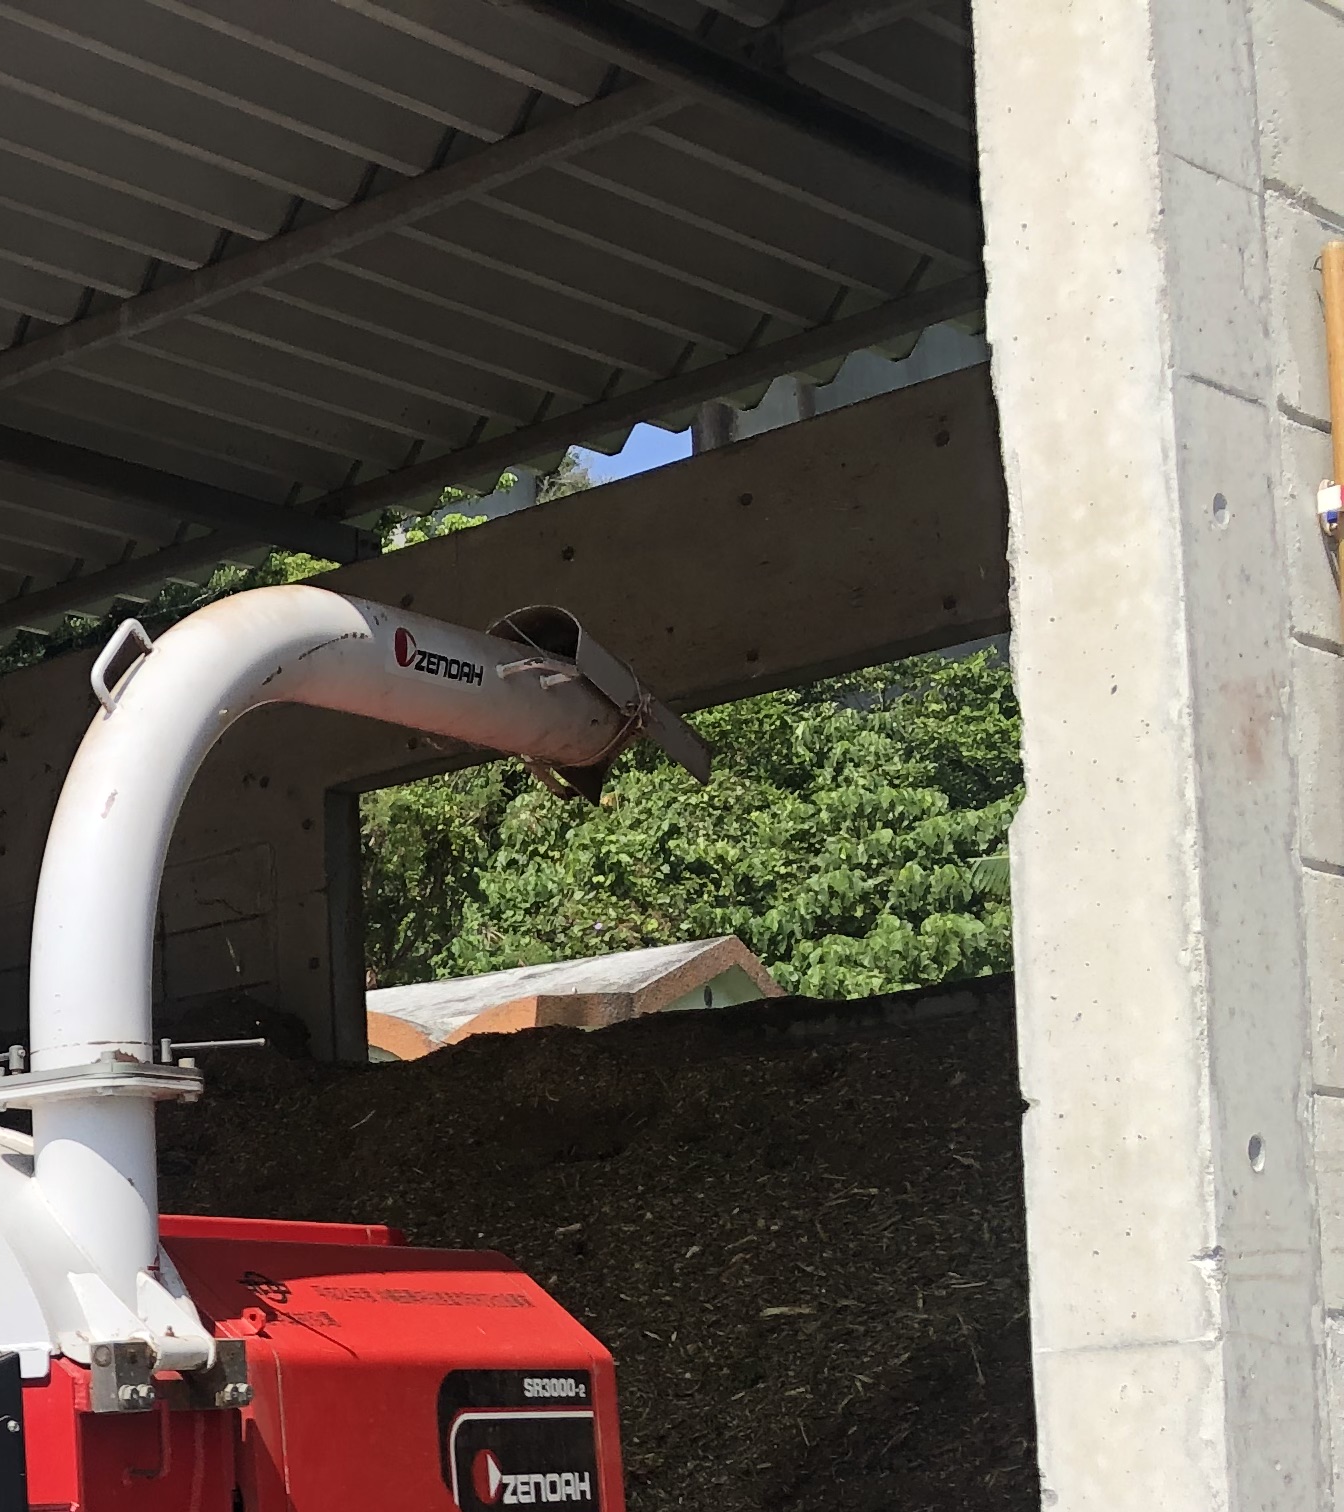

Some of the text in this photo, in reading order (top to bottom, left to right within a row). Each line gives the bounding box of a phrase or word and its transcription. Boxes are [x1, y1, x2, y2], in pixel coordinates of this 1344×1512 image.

[414, 649, 484, 686] ZENOAH
[523, 1377, 587, 1397] SR3000-2
[501, 1472, 591, 1504] ZENOAH
